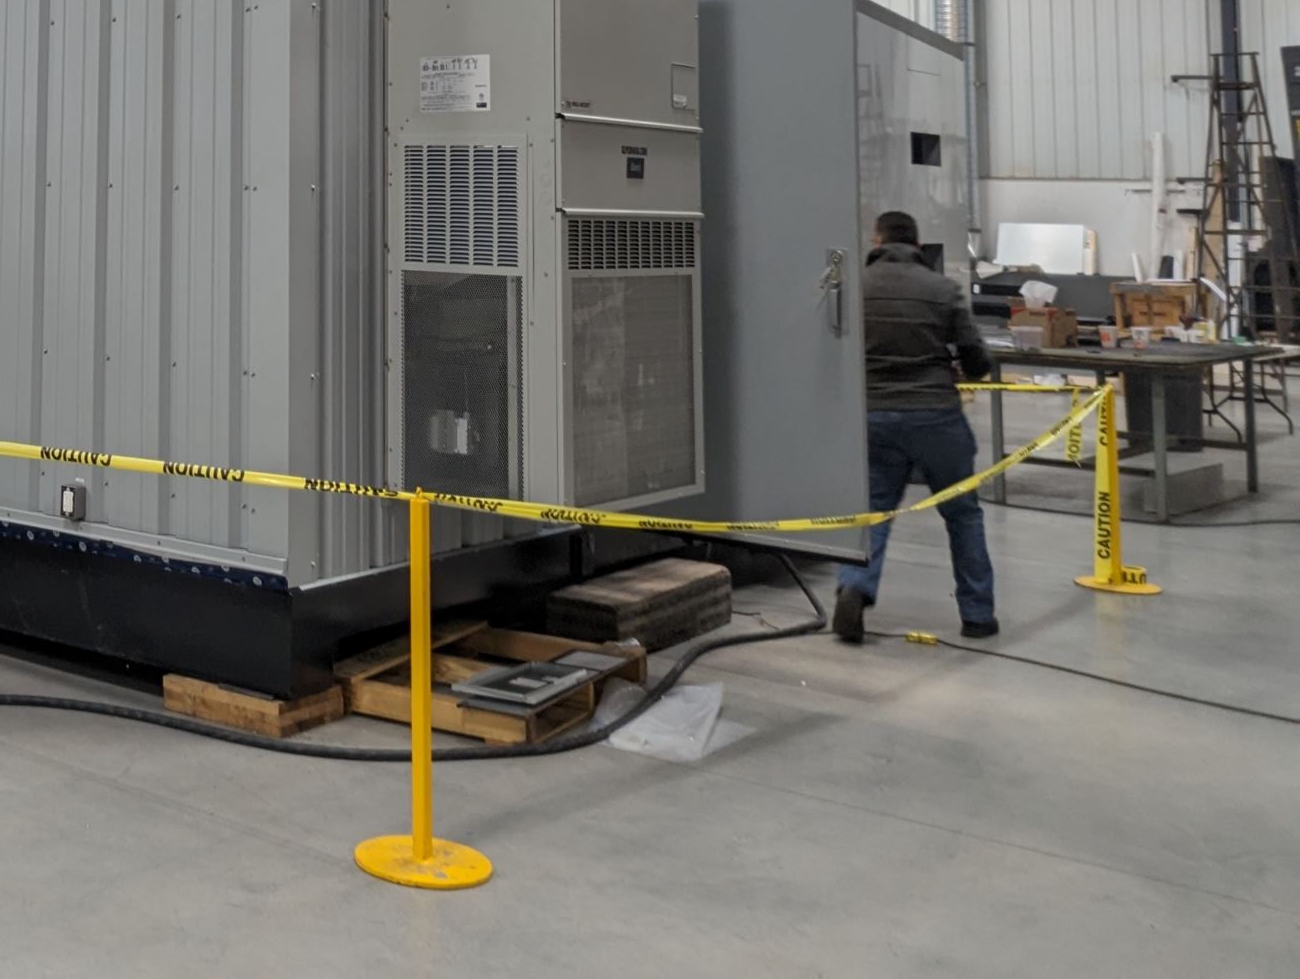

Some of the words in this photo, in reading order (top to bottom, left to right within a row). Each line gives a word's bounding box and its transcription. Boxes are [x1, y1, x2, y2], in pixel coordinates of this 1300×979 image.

[40, 446, 111, 467] CAUTION
[163, 461, 245, 482] CAUTION
[1097, 491, 1111, 559] CAUTION
